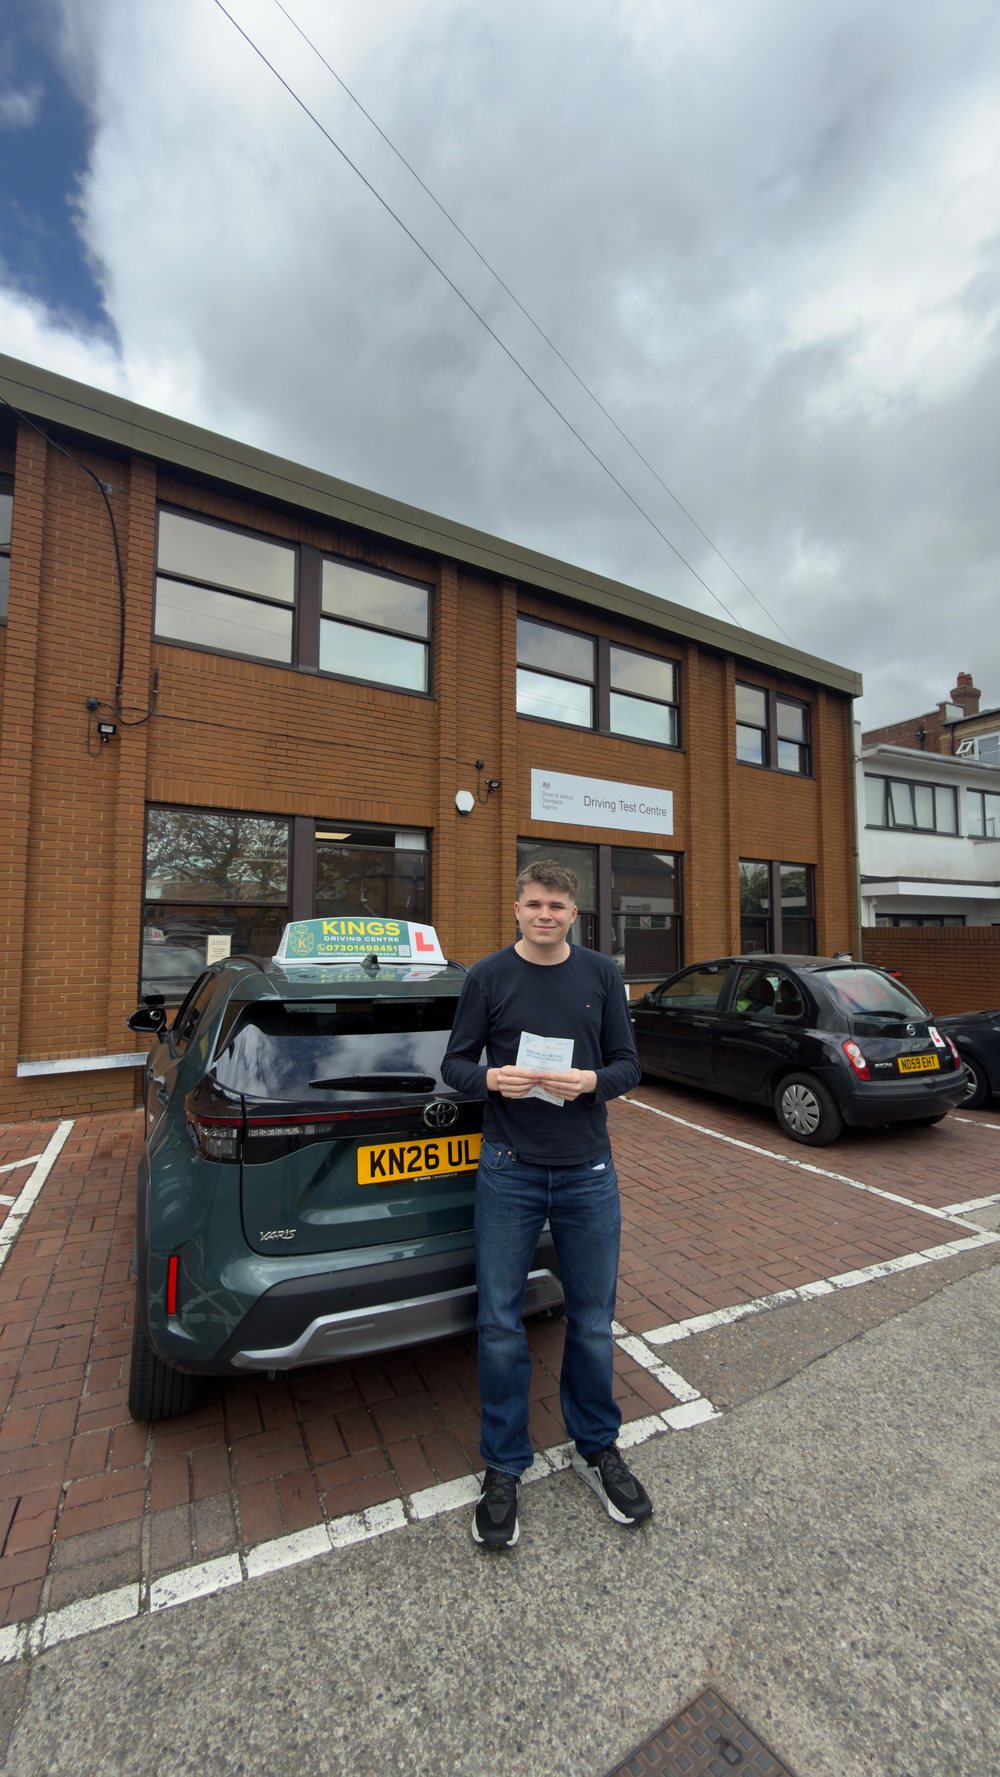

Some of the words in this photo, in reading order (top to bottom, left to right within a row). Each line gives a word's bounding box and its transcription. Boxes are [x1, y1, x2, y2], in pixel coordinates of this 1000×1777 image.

[583, 795, 616, 812] Driving
[619, 800, 637, 813] Test
[639, 803, 667, 816] Centre
[322, 920, 400, 936] KINGS
[415, 932, 435, 951] L
[931, 1031, 941, 1043] L
[901, 1057, 921, 1070] ND59
[922, 1056, 938, 1068] EHT
[369, 1143, 439, 1178] KN26
[447, 1138, 483, 1167] UL
[260, 1229, 297, 1241] YARIS
